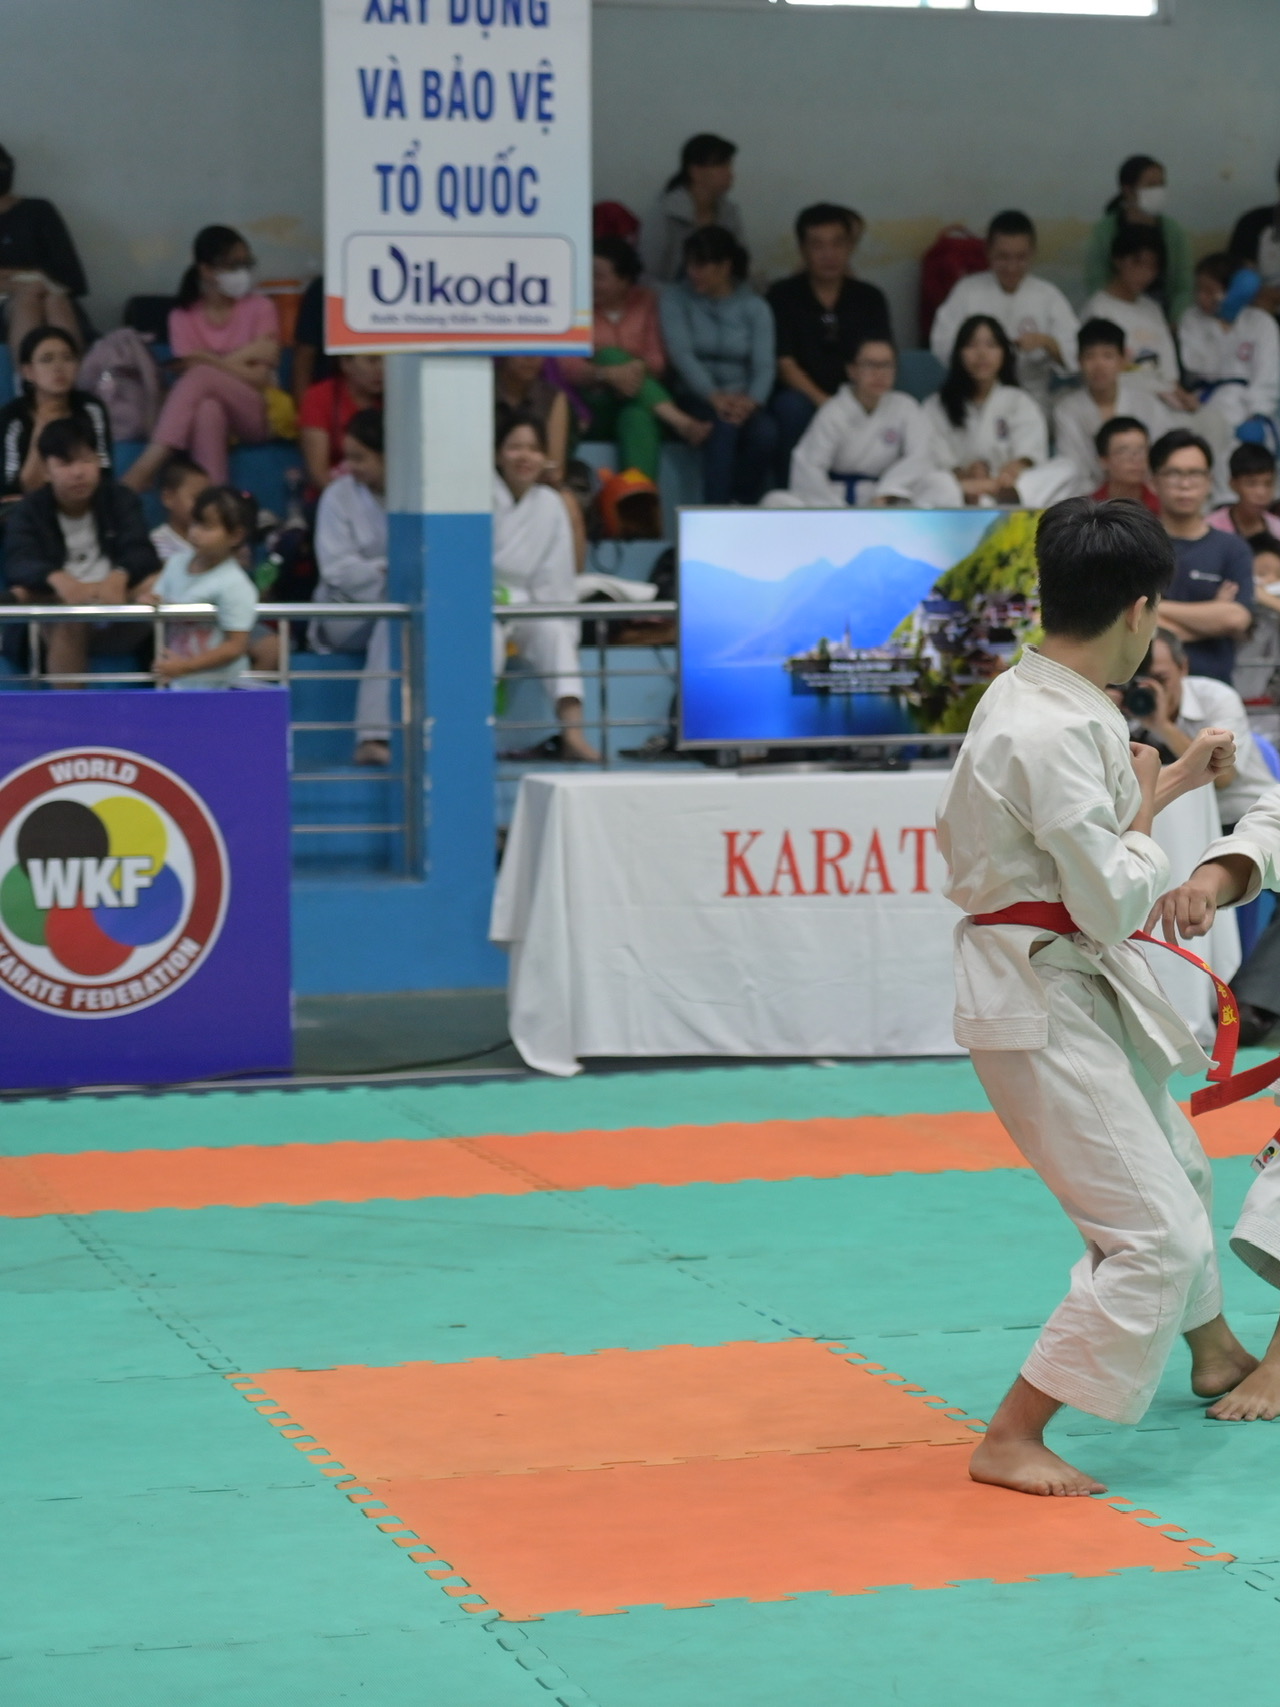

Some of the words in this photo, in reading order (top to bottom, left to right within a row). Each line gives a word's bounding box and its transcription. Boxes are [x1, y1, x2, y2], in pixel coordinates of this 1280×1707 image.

[357, 54, 408, 119] VÀ
[422, 54, 495, 121] BẢO
[509, 58, 555, 135] VỆ
[374, 138, 422, 214] TỔ
[438, 144, 539, 219] QUỐC
[370, 243, 549, 306] Vikoda
[49, 758, 138, 784] WORLD
[27, 856, 153, 909] WKF
[721, 827, 952, 897] KARAT
[0, 942, 67, 1006] ARATE
[71, 937, 201, 1010] FEDERATION
